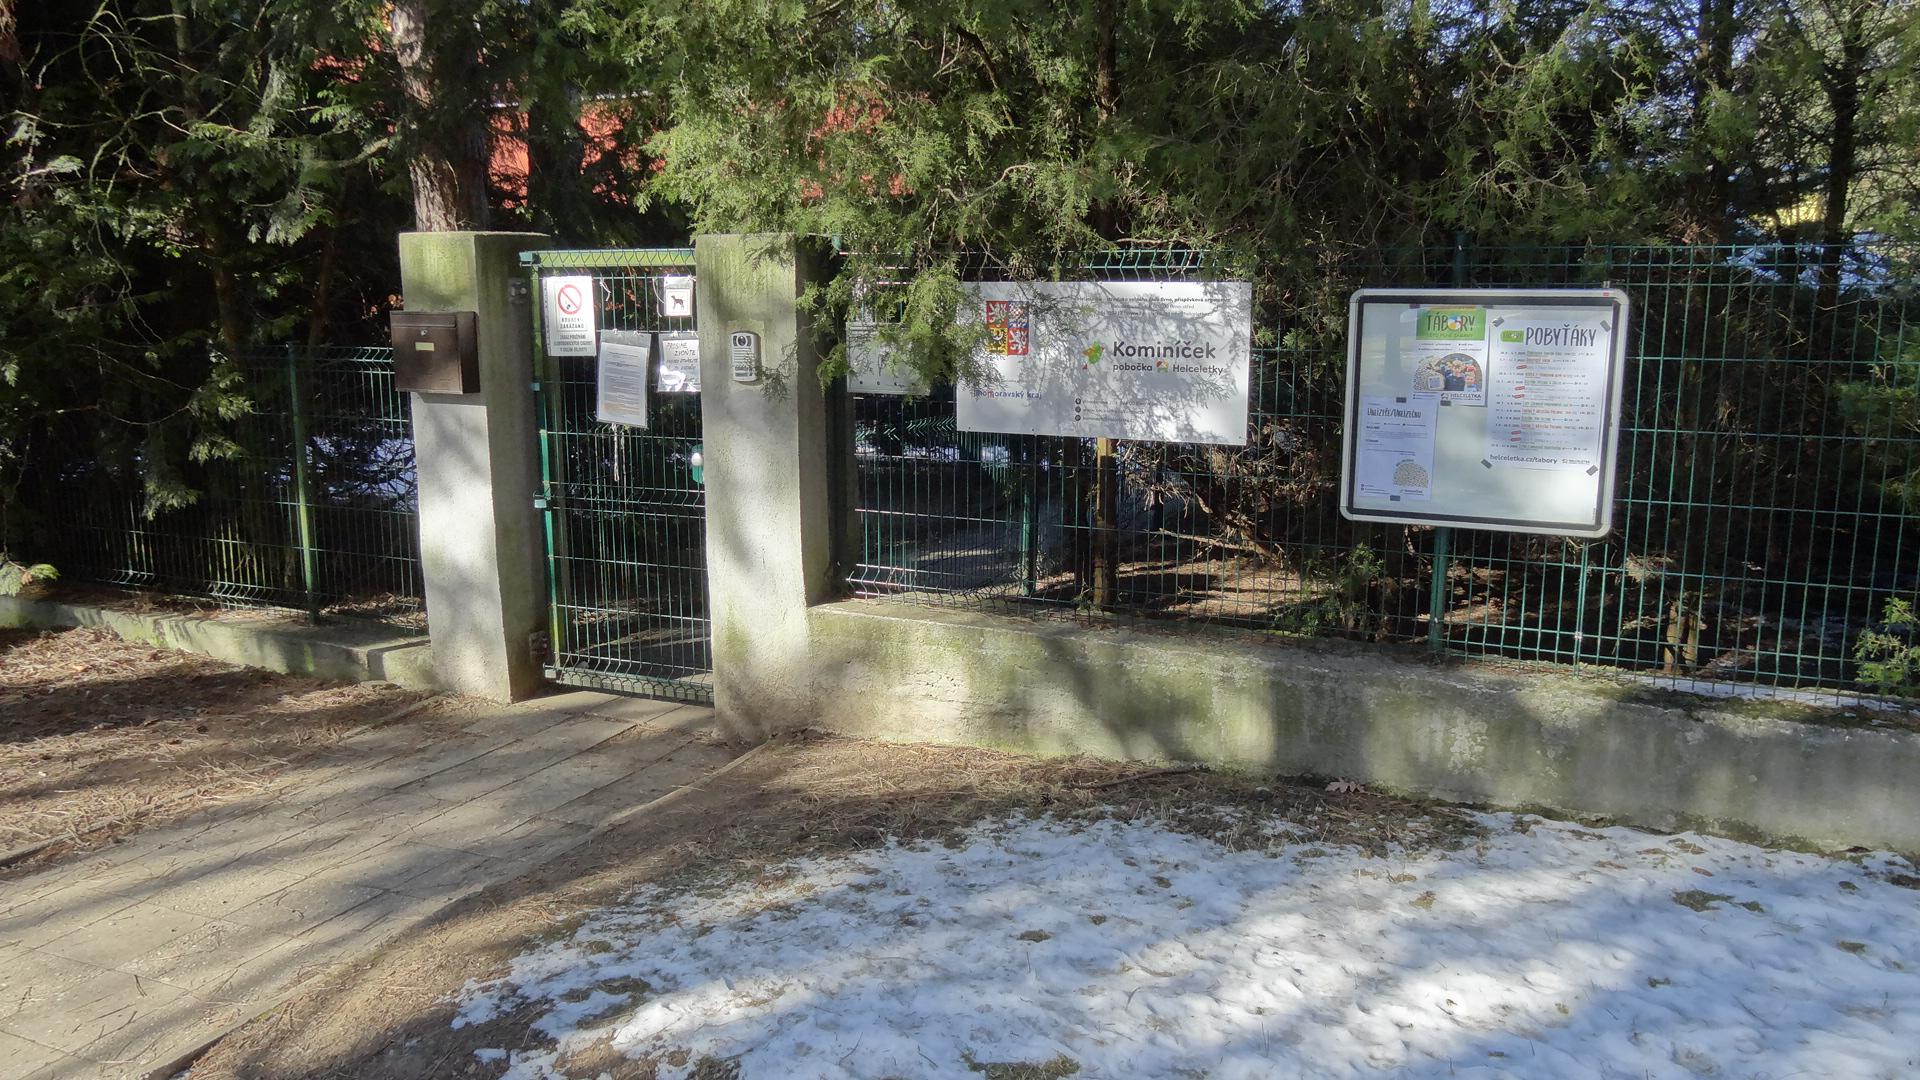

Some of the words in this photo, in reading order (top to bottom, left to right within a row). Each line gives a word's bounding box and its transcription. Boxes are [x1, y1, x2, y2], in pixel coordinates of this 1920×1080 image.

[1525, 323, 1597, 347] POBYŤÁKY
[1113, 340, 1216, 360] Kominíček
[1113, 363, 1153, 373] pobočka
[1027, 391, 1043, 400] kraj
